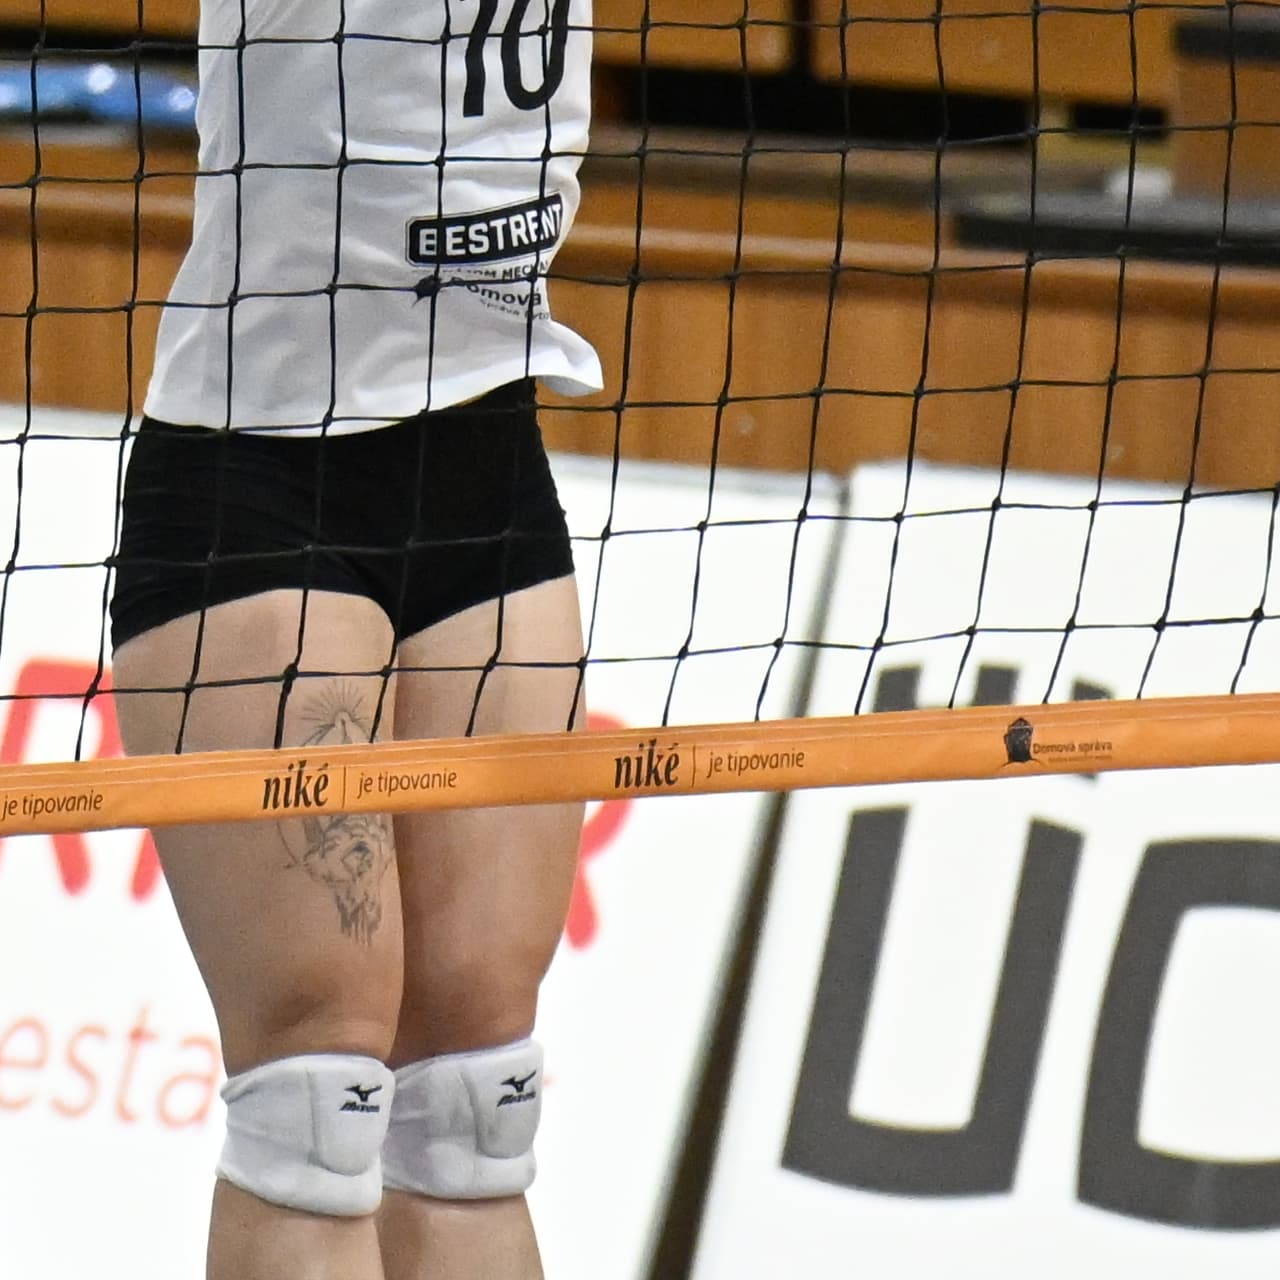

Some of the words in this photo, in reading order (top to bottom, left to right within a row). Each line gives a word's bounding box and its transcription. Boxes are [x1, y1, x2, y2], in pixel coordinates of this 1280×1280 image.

[418, 203, 562, 256] BESTRENT
[356, 771, 374, 799] je
[377, 767, 457, 797] tipovanie
[613, 738, 680, 789] niké
[706, 751, 724, 778] je
[727, 747, 805, 777] tipovanie
[0, 794, 18, 822] je
[21, 789, 104, 819] tipovanie
[261, 759, 329, 810] niké
